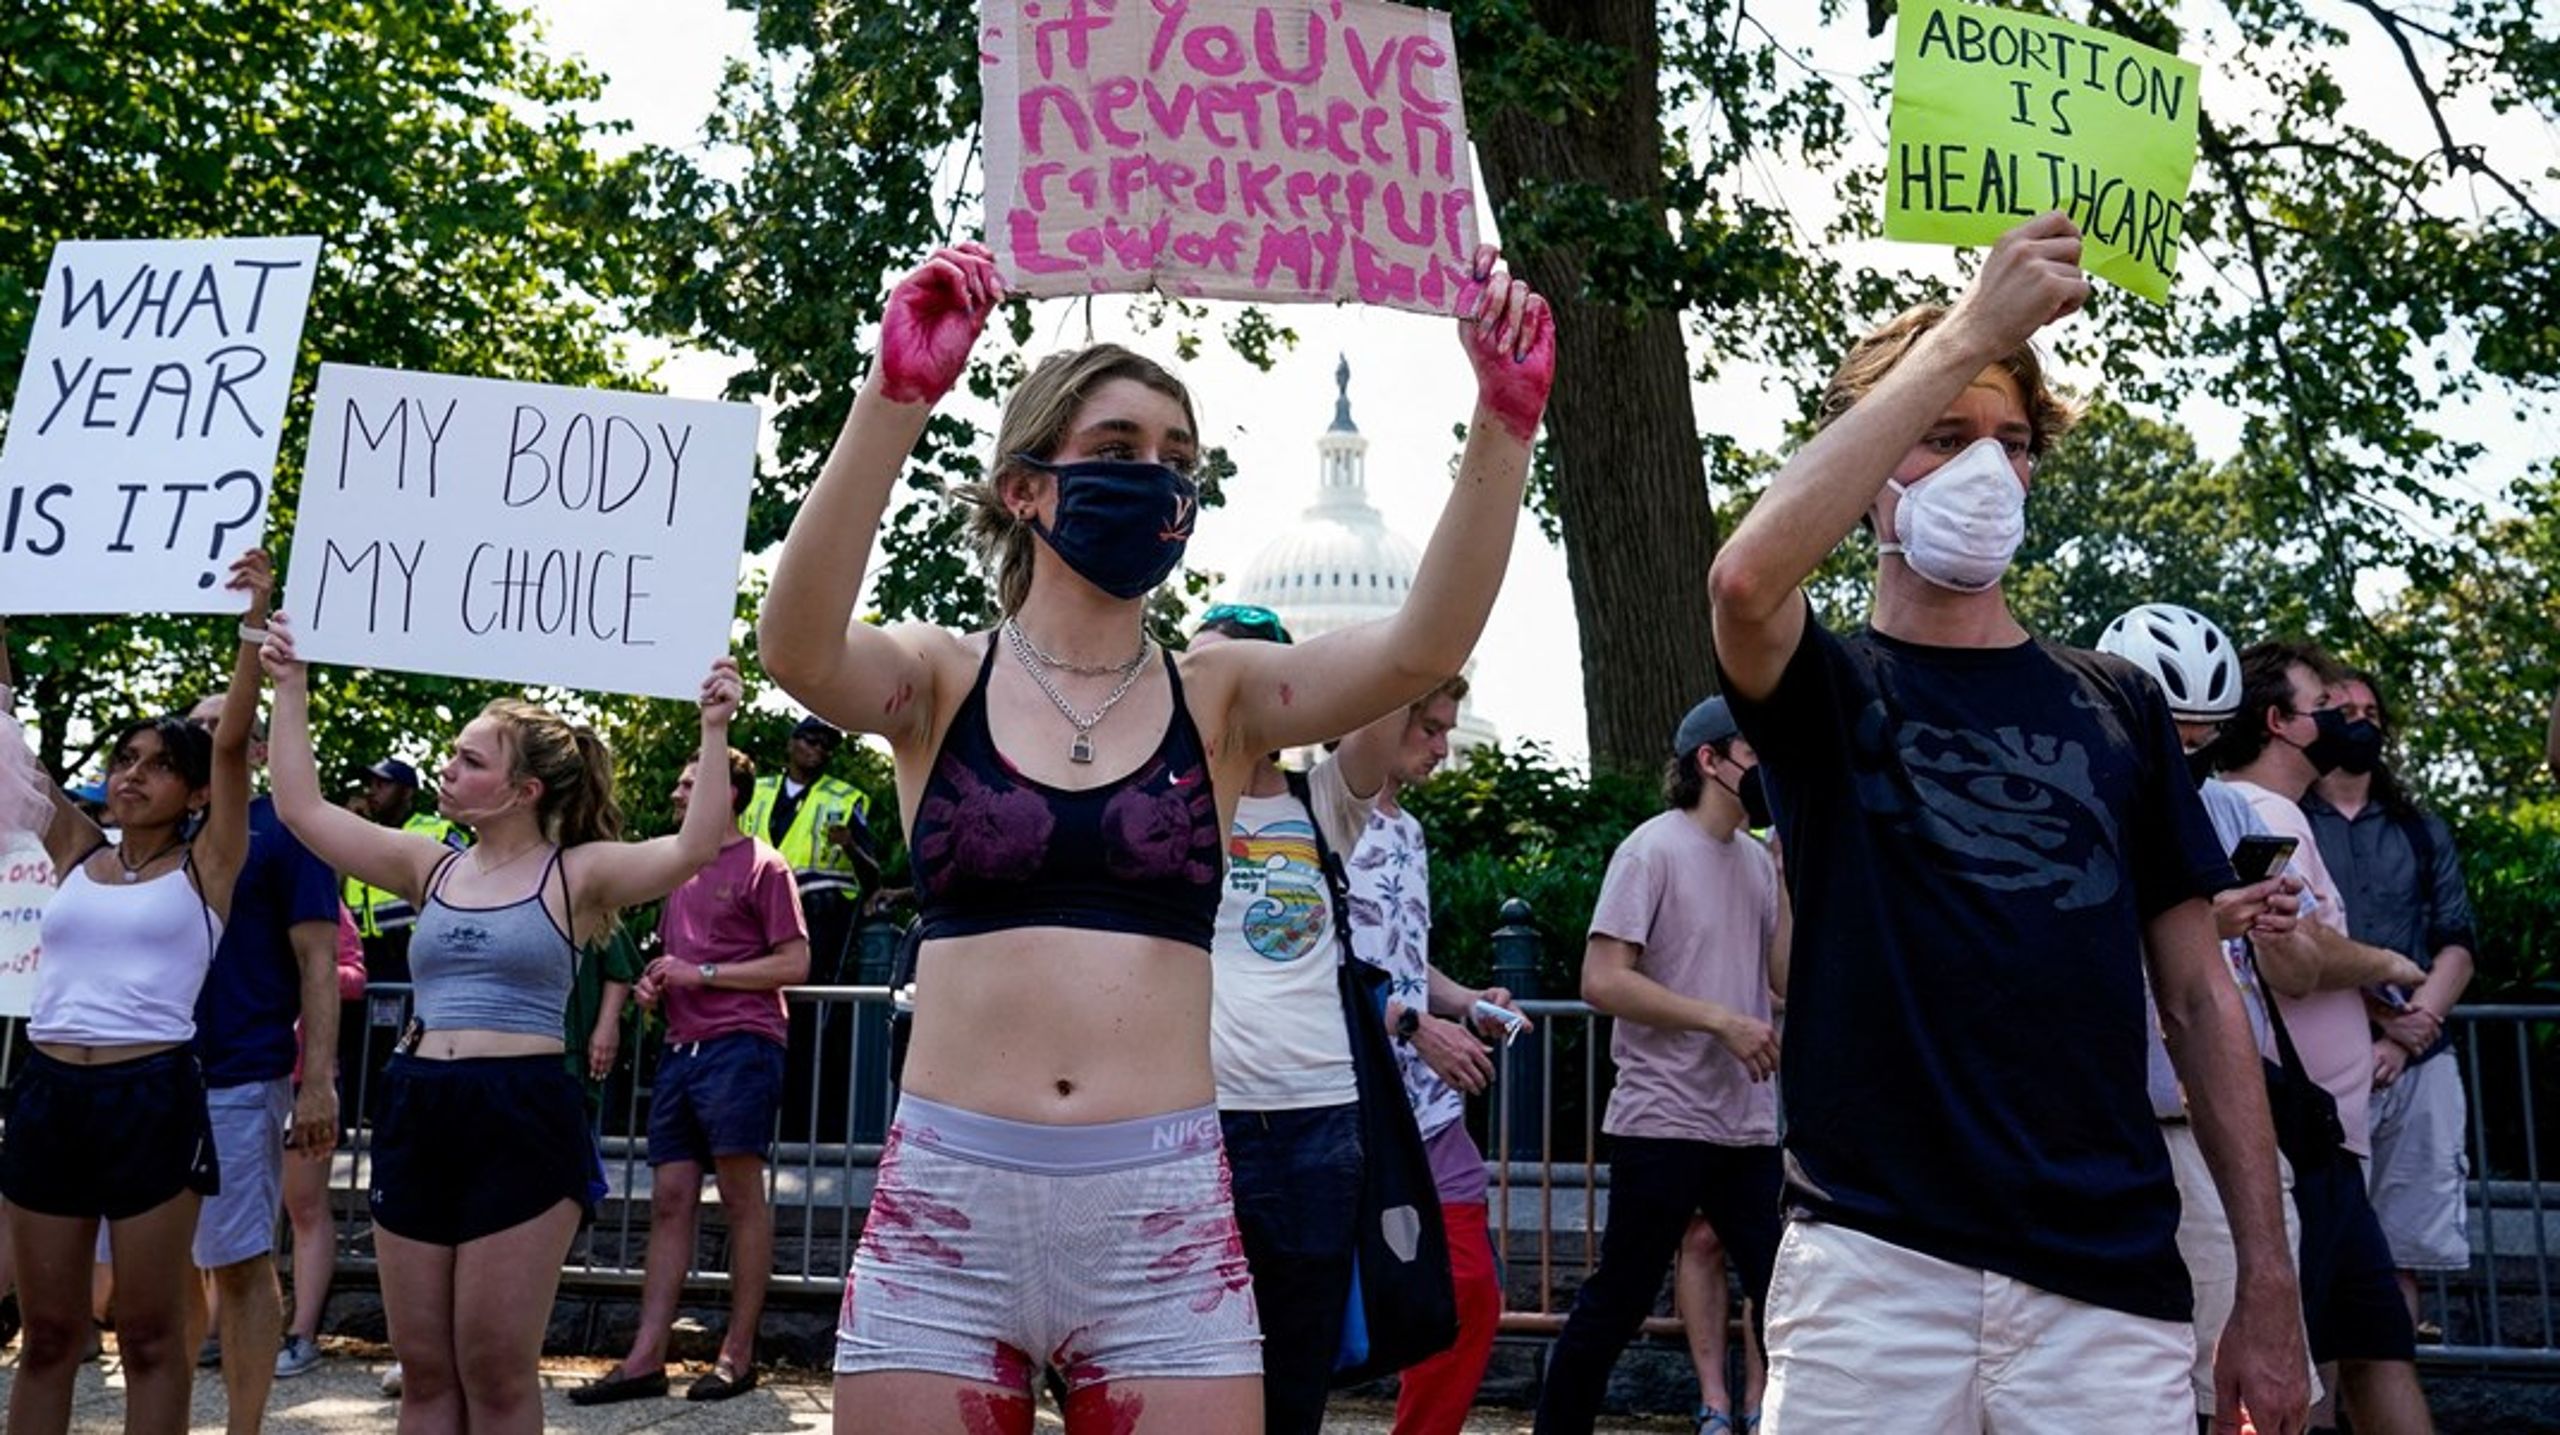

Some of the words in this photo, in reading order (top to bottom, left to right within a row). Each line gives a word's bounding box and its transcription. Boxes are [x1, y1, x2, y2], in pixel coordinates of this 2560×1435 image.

[1918, 8, 2184, 121] ABORTION
[2009, 80, 2072, 136] IS
[1019, 76, 1276, 154] never
[1277, 86, 1454, 181] been
[1900, 143, 2183, 278] HEALTHCARE
[61, 259, 303, 340] WHAT
[37, 345, 268, 440] YEAR
[338, 397, 458, 498] MY
[503, 404, 692, 527] BODY
[2, 482, 73, 556] IS
[106, 469, 264, 590] IT?
[313, 538, 426, 633] MY
[460, 541, 656, 645] CHOICE
[1152, 1113, 1214, 1151] NIKE
